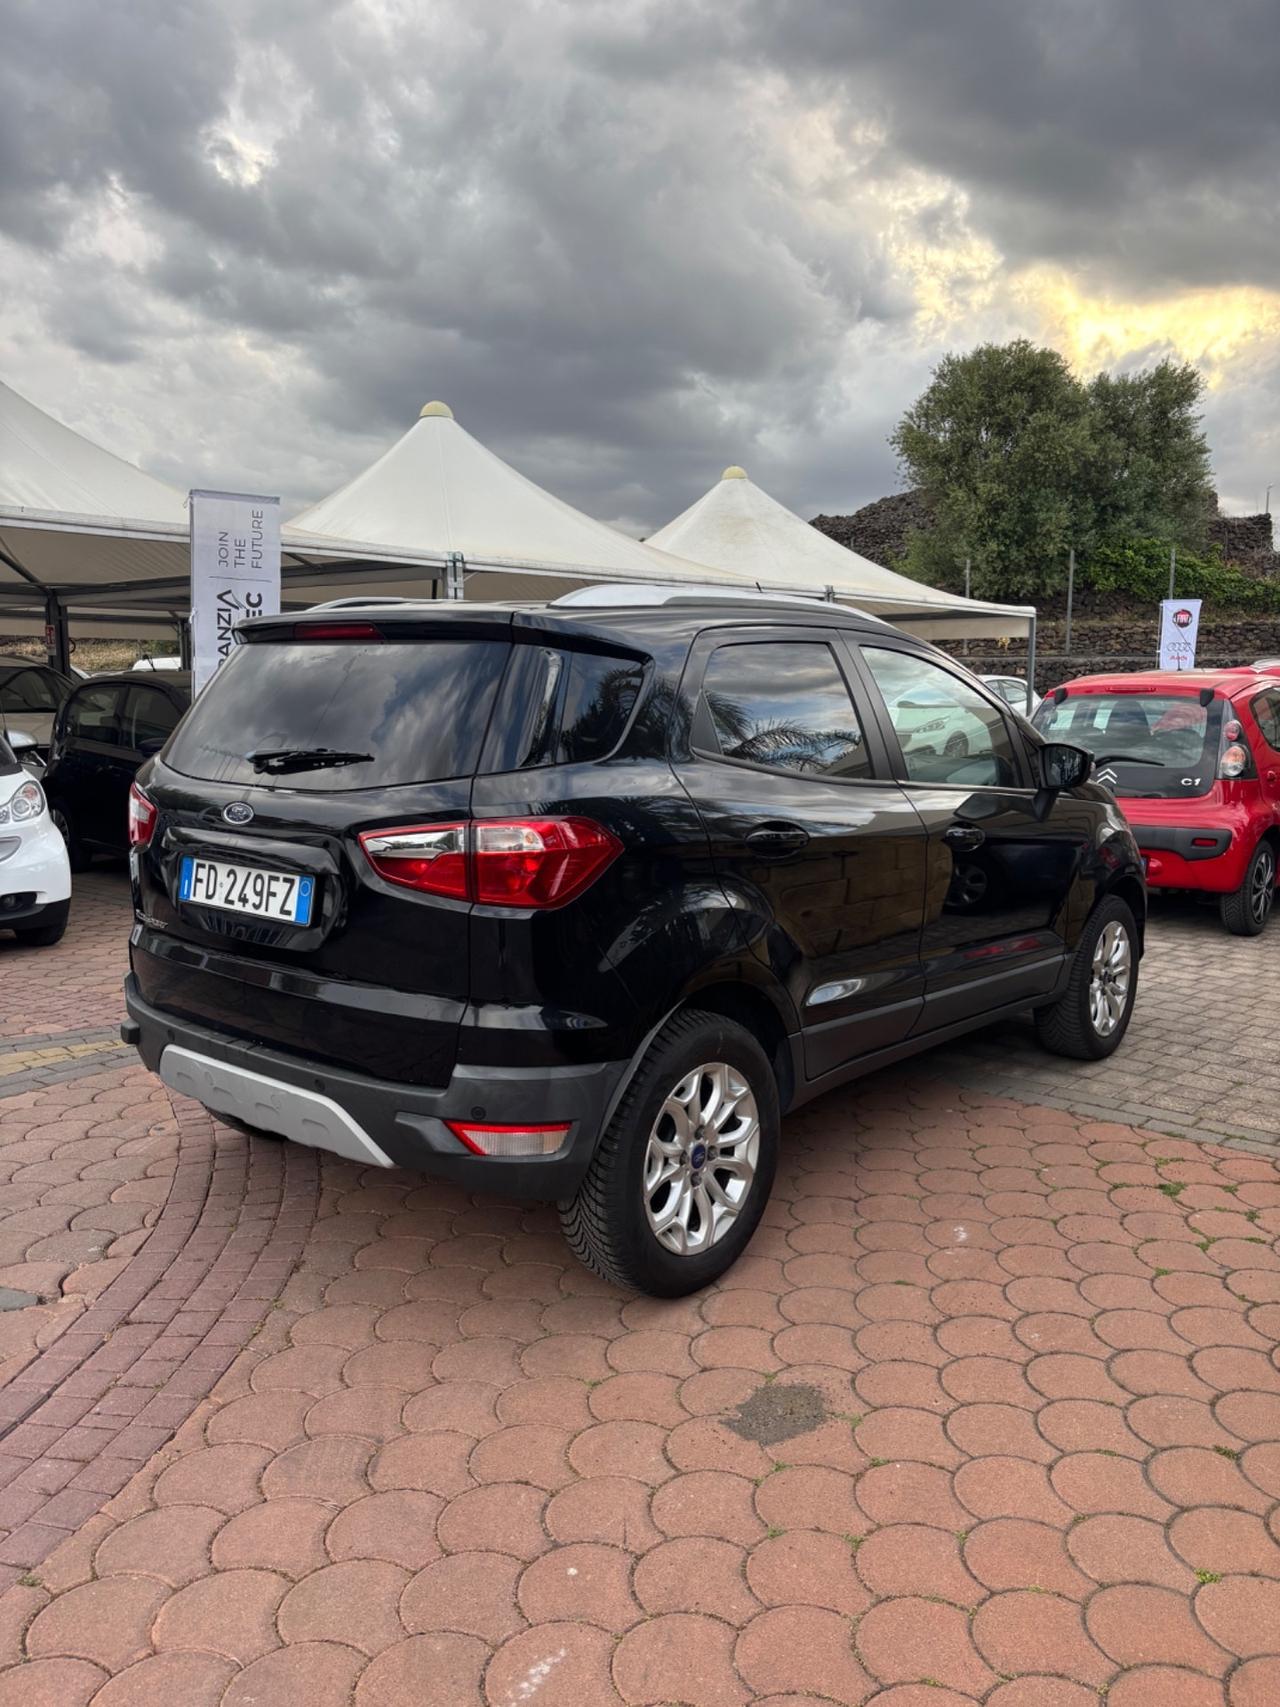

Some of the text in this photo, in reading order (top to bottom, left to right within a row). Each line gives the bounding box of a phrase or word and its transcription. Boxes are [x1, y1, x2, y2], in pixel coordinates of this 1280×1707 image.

[218, 531, 230, 568] JOIN
[233, 537, 247, 569] THE
[251, 509, 264, 569] FUTURE
[1180, 777, 1202, 787] C1
[192, 862, 218, 900] FD
[224, 868, 295, 916] 249FZ
